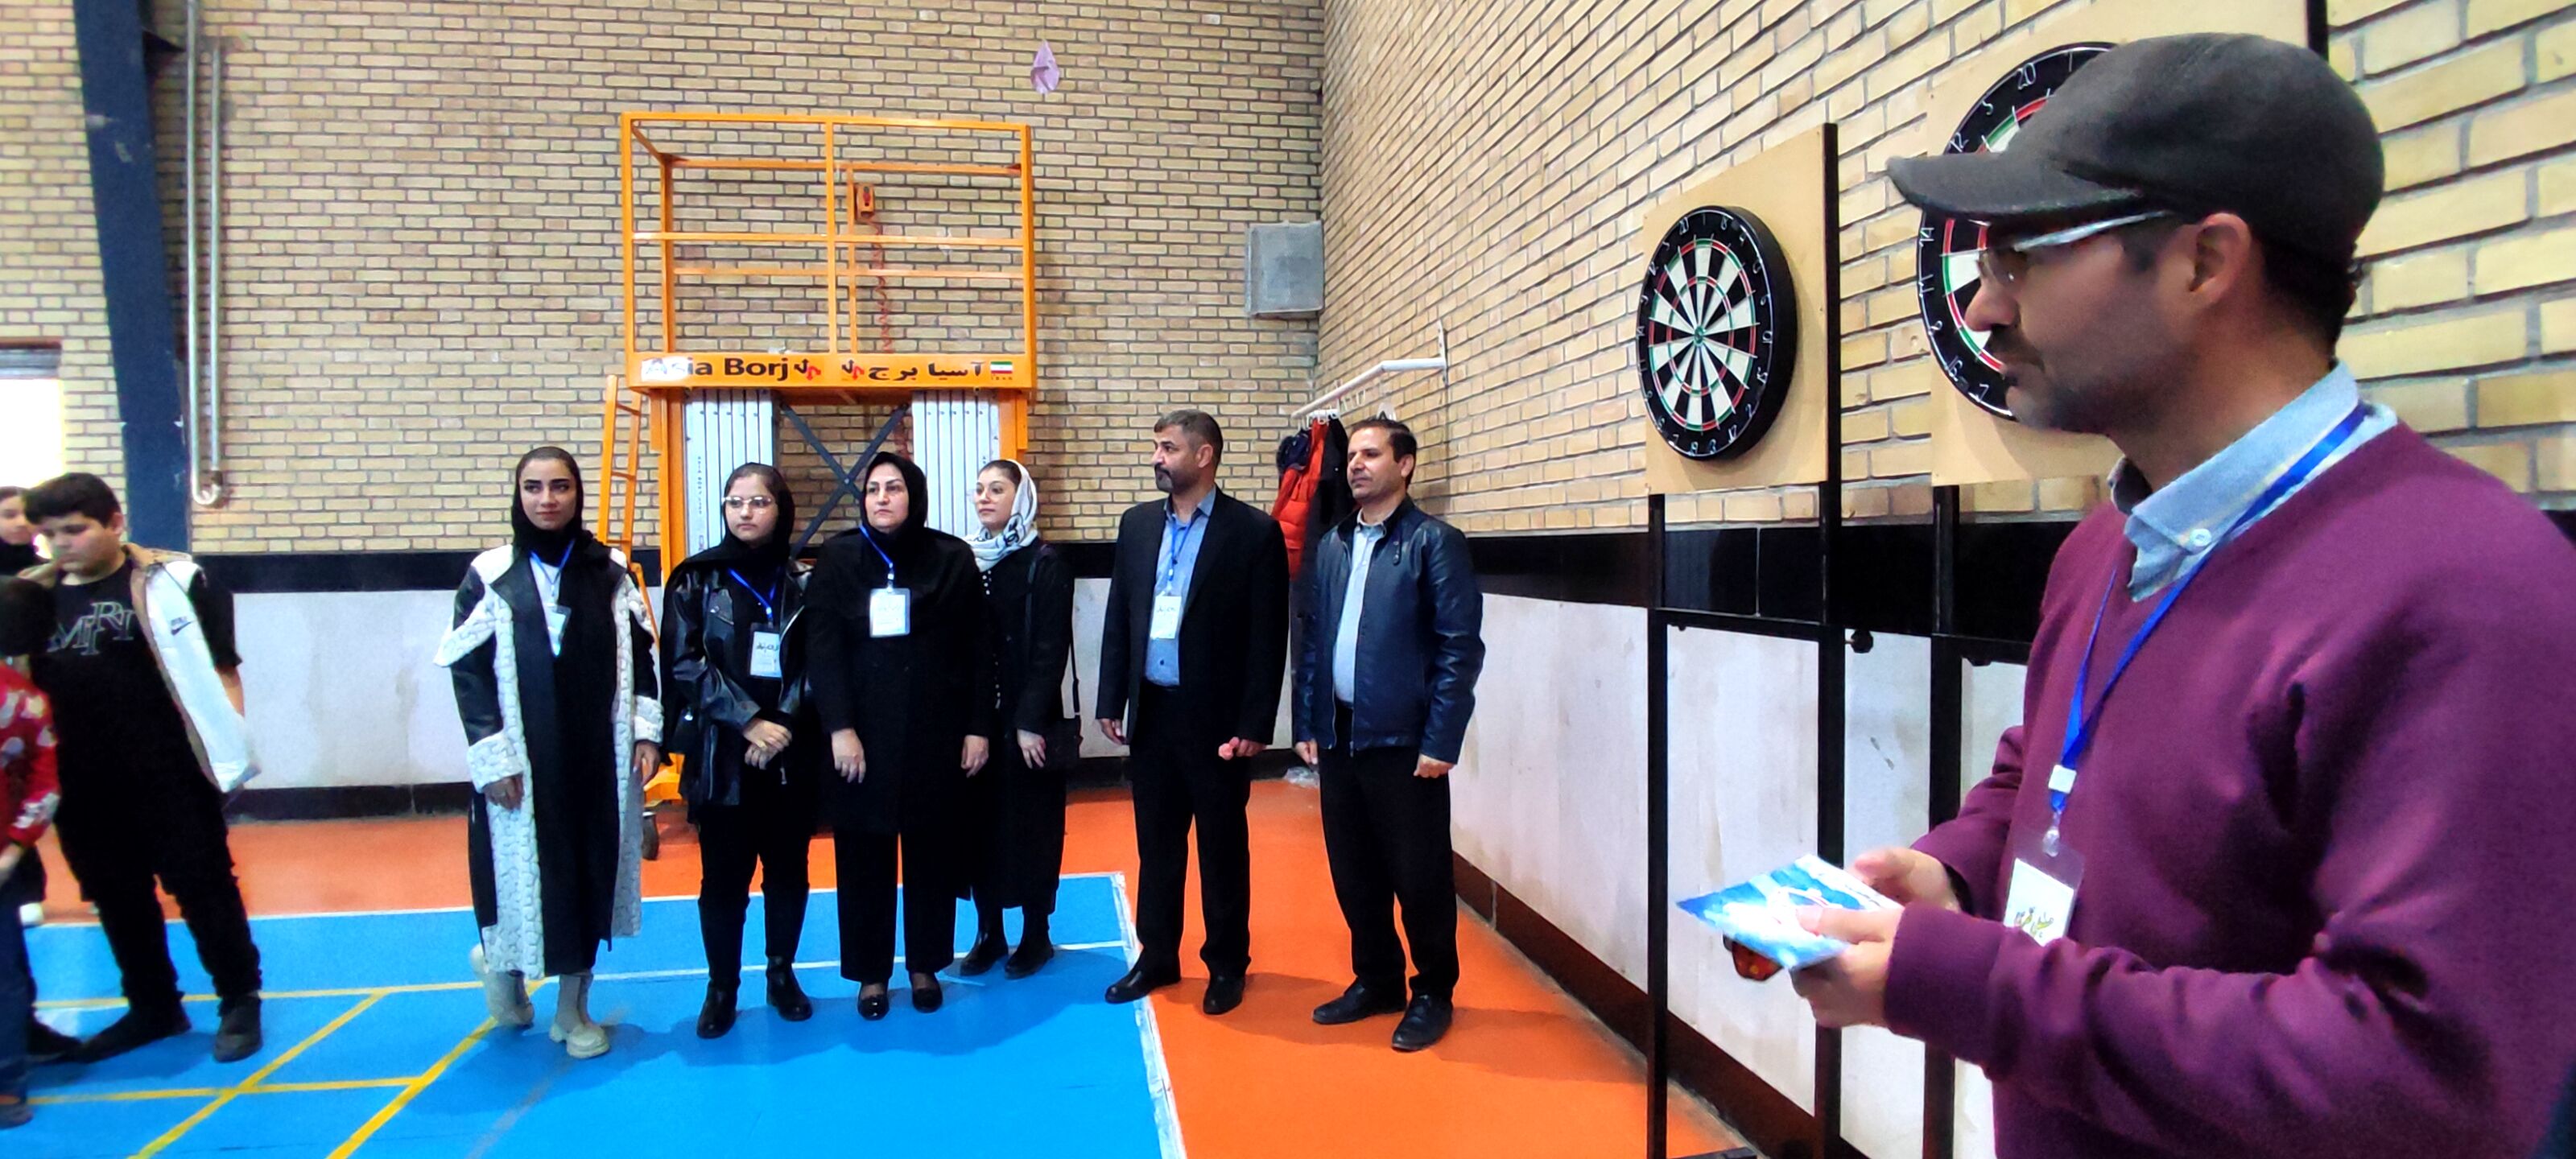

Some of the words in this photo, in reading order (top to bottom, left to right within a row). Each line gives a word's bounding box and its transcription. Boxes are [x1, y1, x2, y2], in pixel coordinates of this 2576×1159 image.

[2016, 62, 2037, 90] 20
[1982, 100, 1994, 115] 5
[1950, 132, 1970, 153] 12
[724, 357, 789, 382] Borj
[868, 366, 919, 382] برج
[927, 361, 986, 381] آسیا
